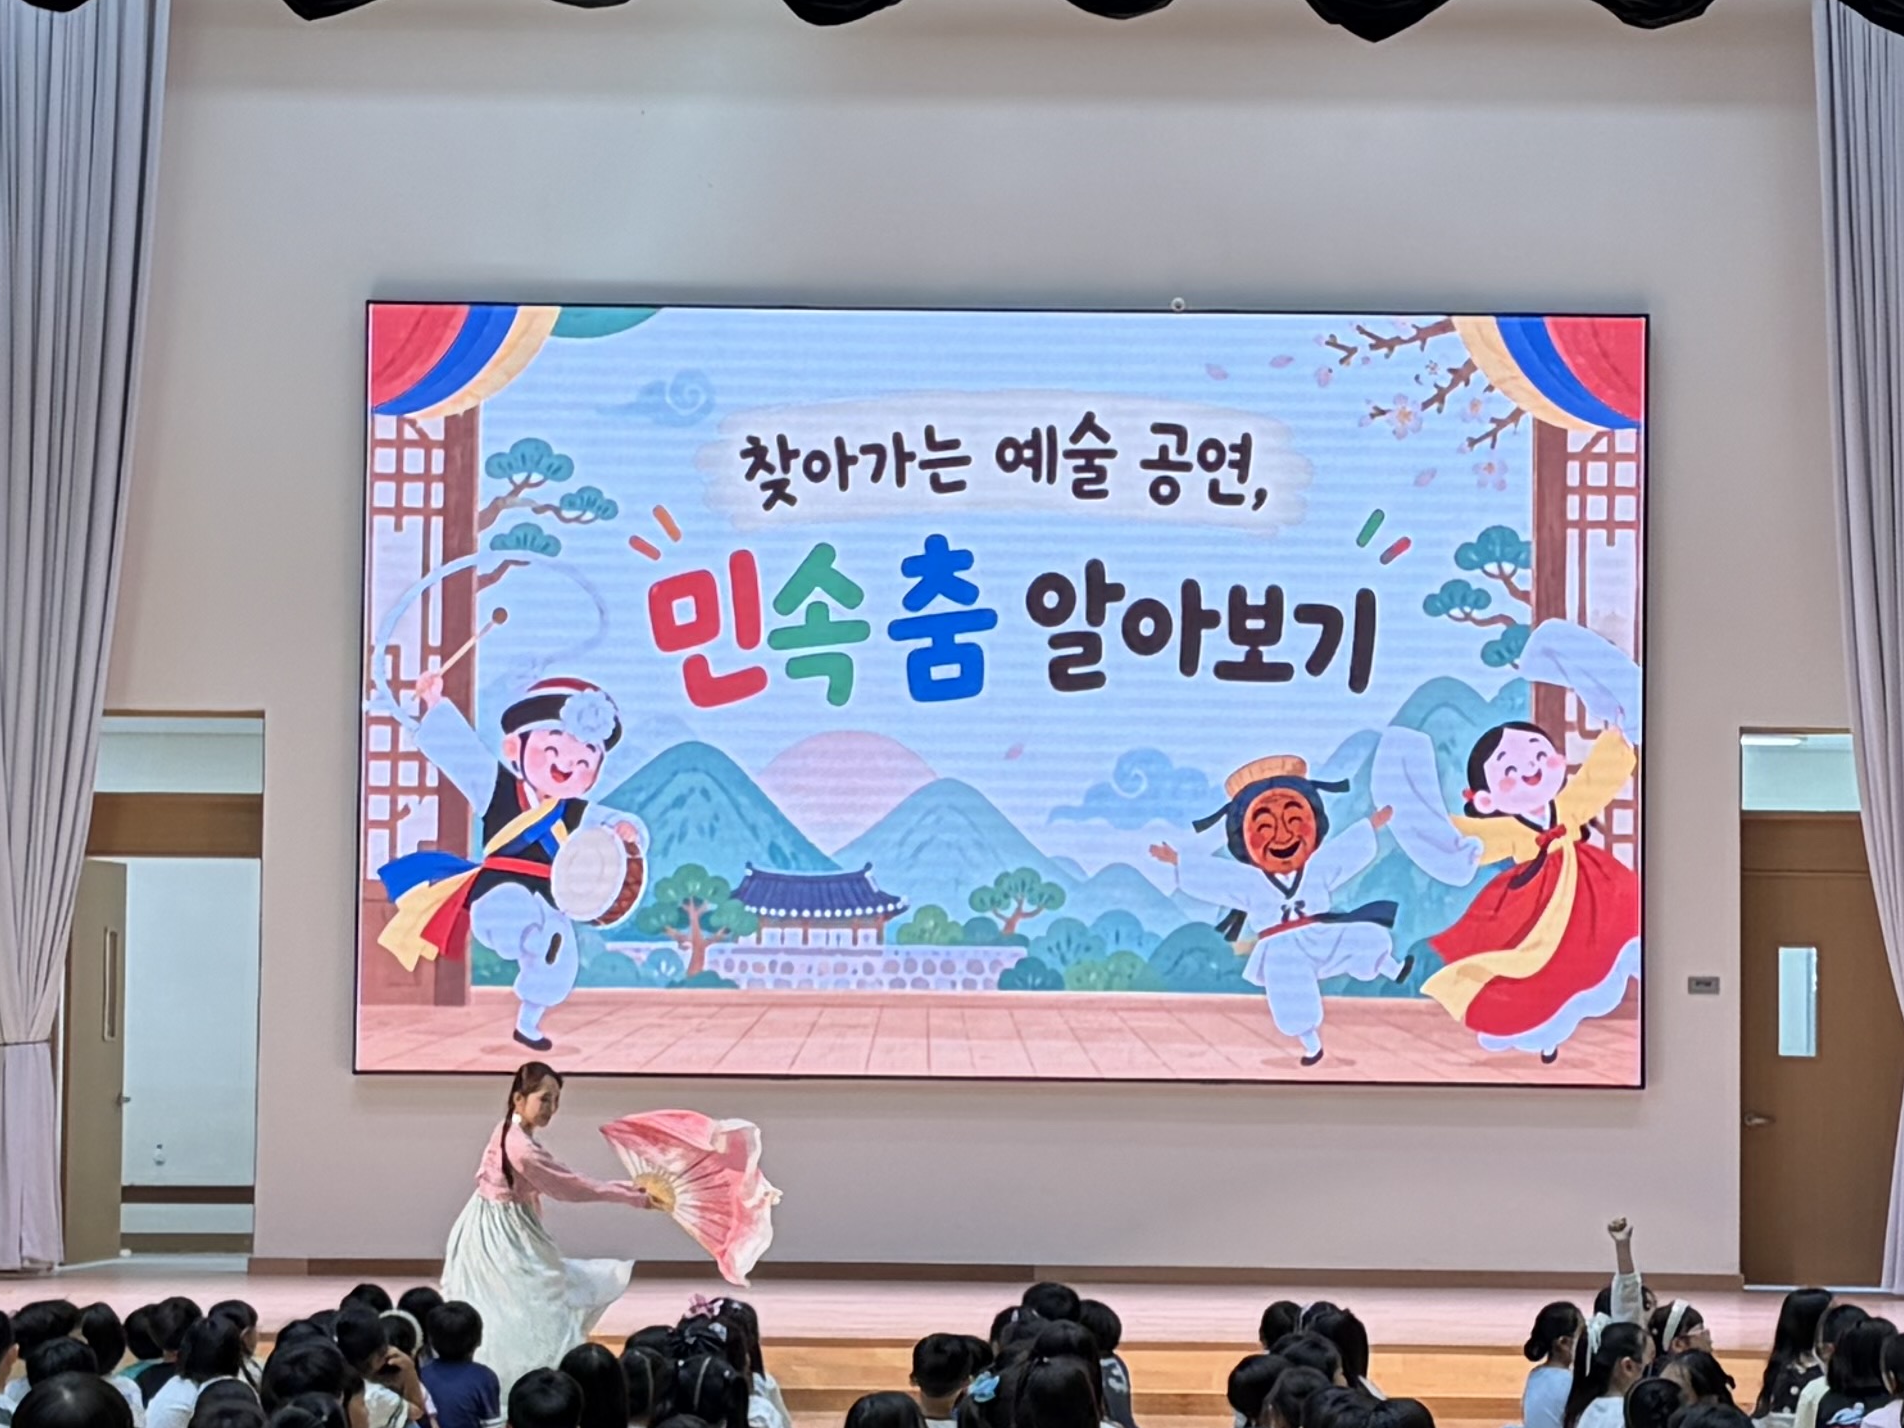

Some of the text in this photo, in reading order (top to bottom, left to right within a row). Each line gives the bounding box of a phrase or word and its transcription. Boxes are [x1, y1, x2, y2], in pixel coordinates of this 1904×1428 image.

[739, 410, 1268, 512] 찾아가는 예술 공연,
[1025, 557, 1377, 694] 알아보기
